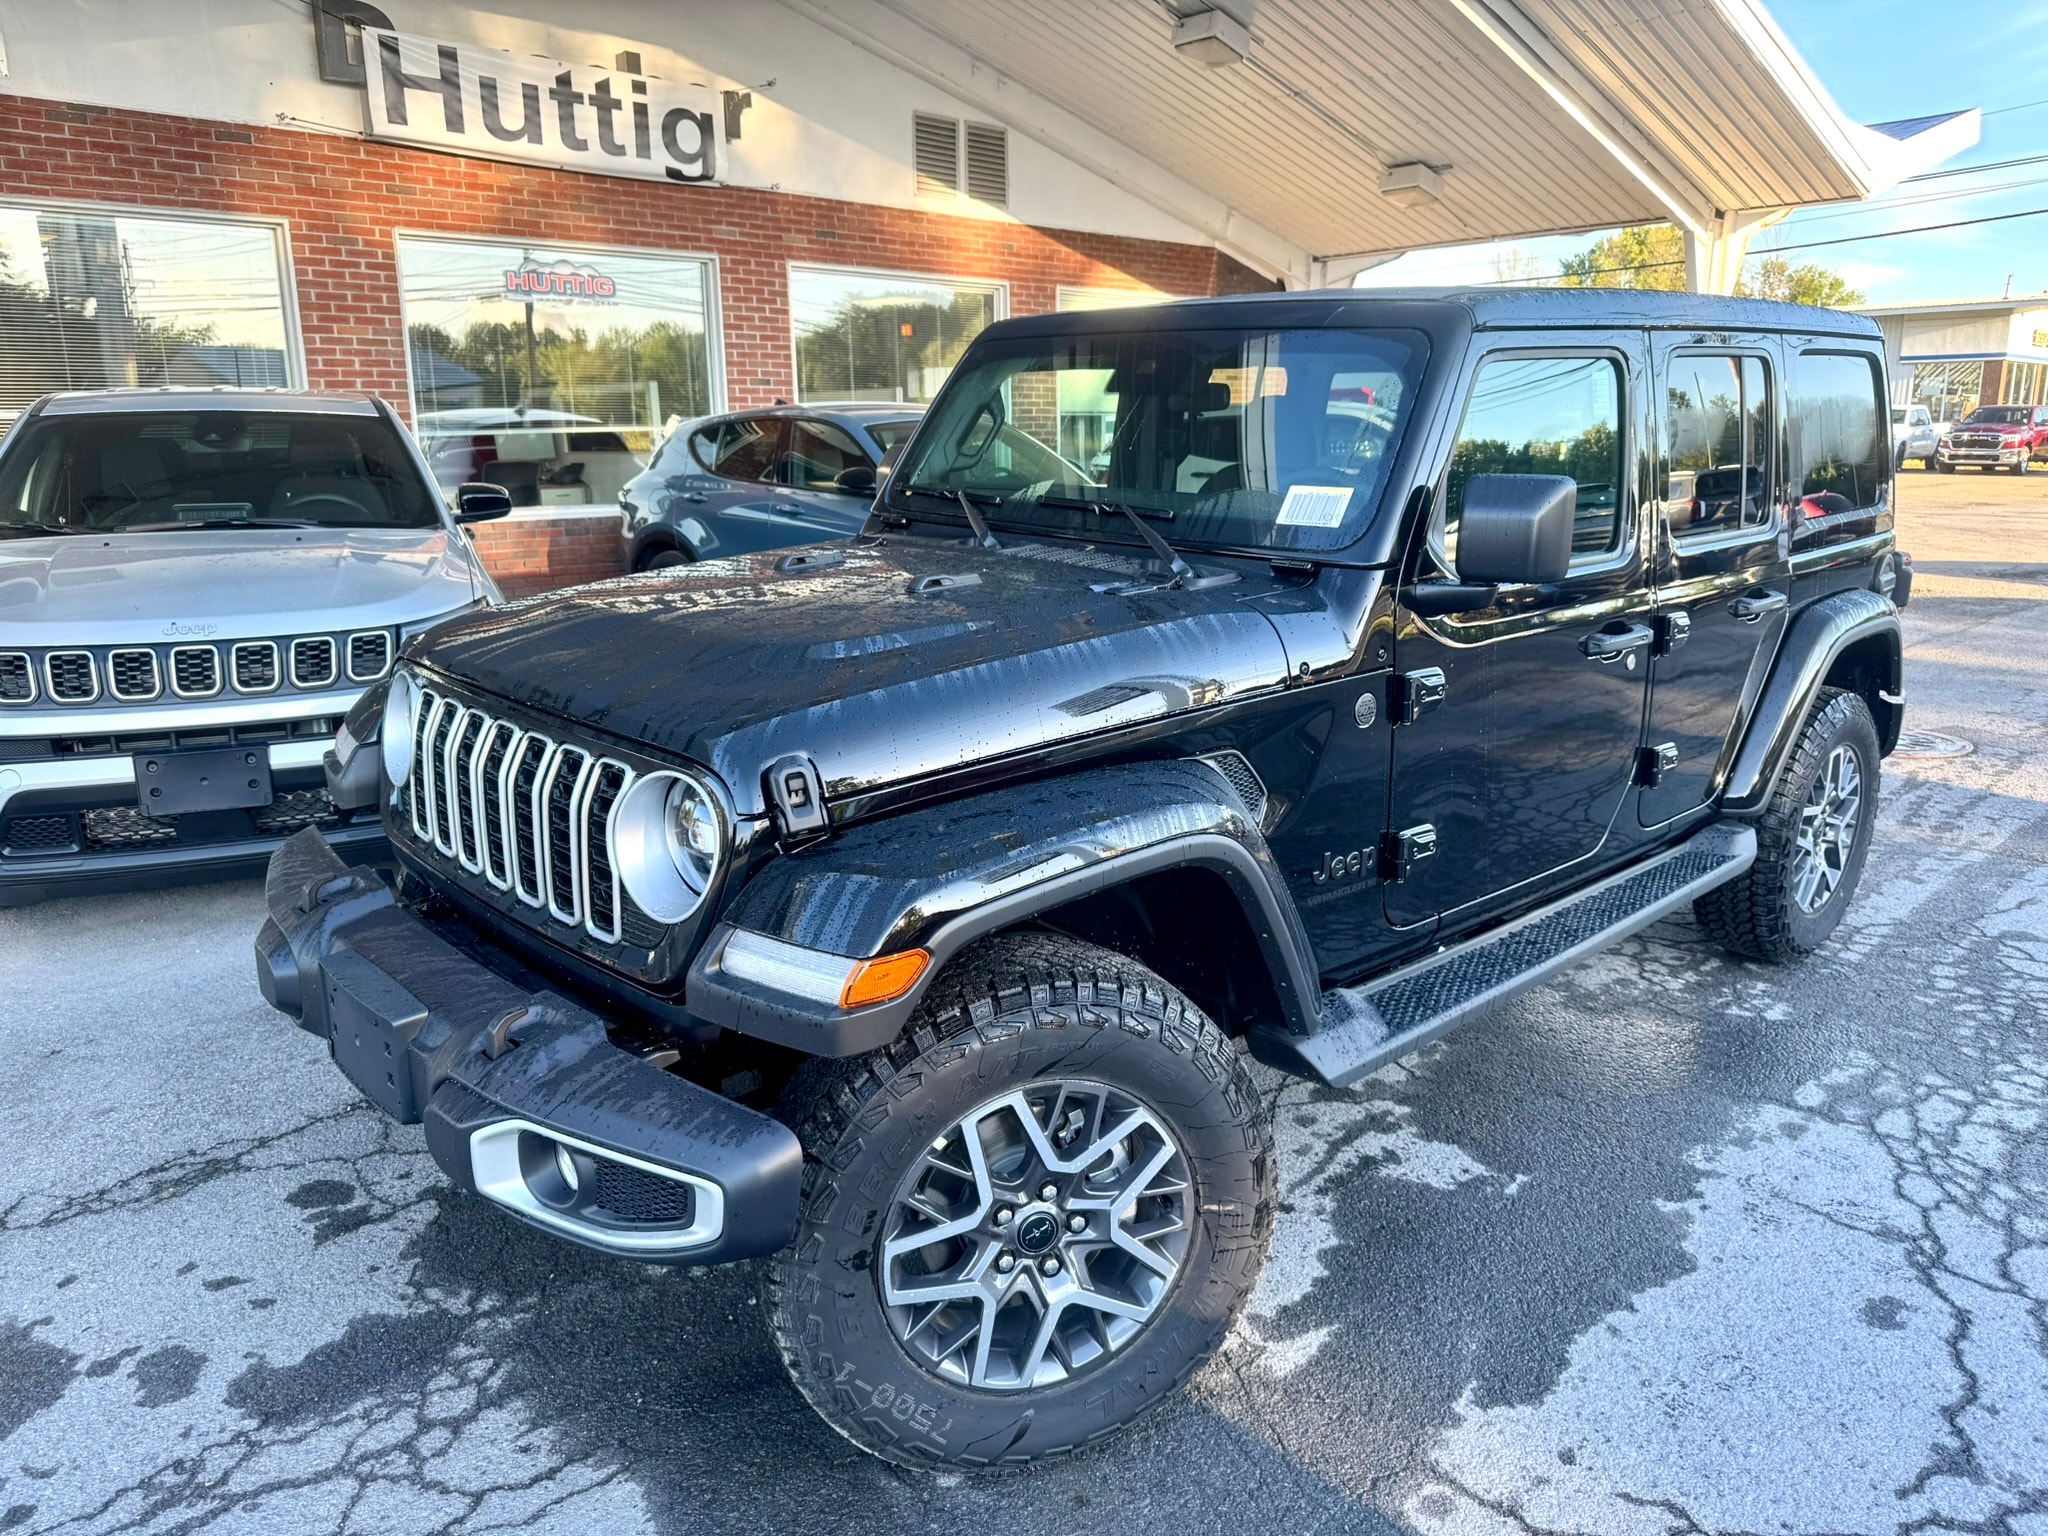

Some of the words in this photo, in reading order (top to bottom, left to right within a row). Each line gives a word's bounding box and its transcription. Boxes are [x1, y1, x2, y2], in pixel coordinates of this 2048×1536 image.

[377, 34, 717, 182] Huttig
[507, 271, 614, 296] HUTTIG
[162, 621, 217, 637] Jeep
[1313, 846, 1377, 885] Jeep
[1307, 881, 1367, 907] WRANGLER
